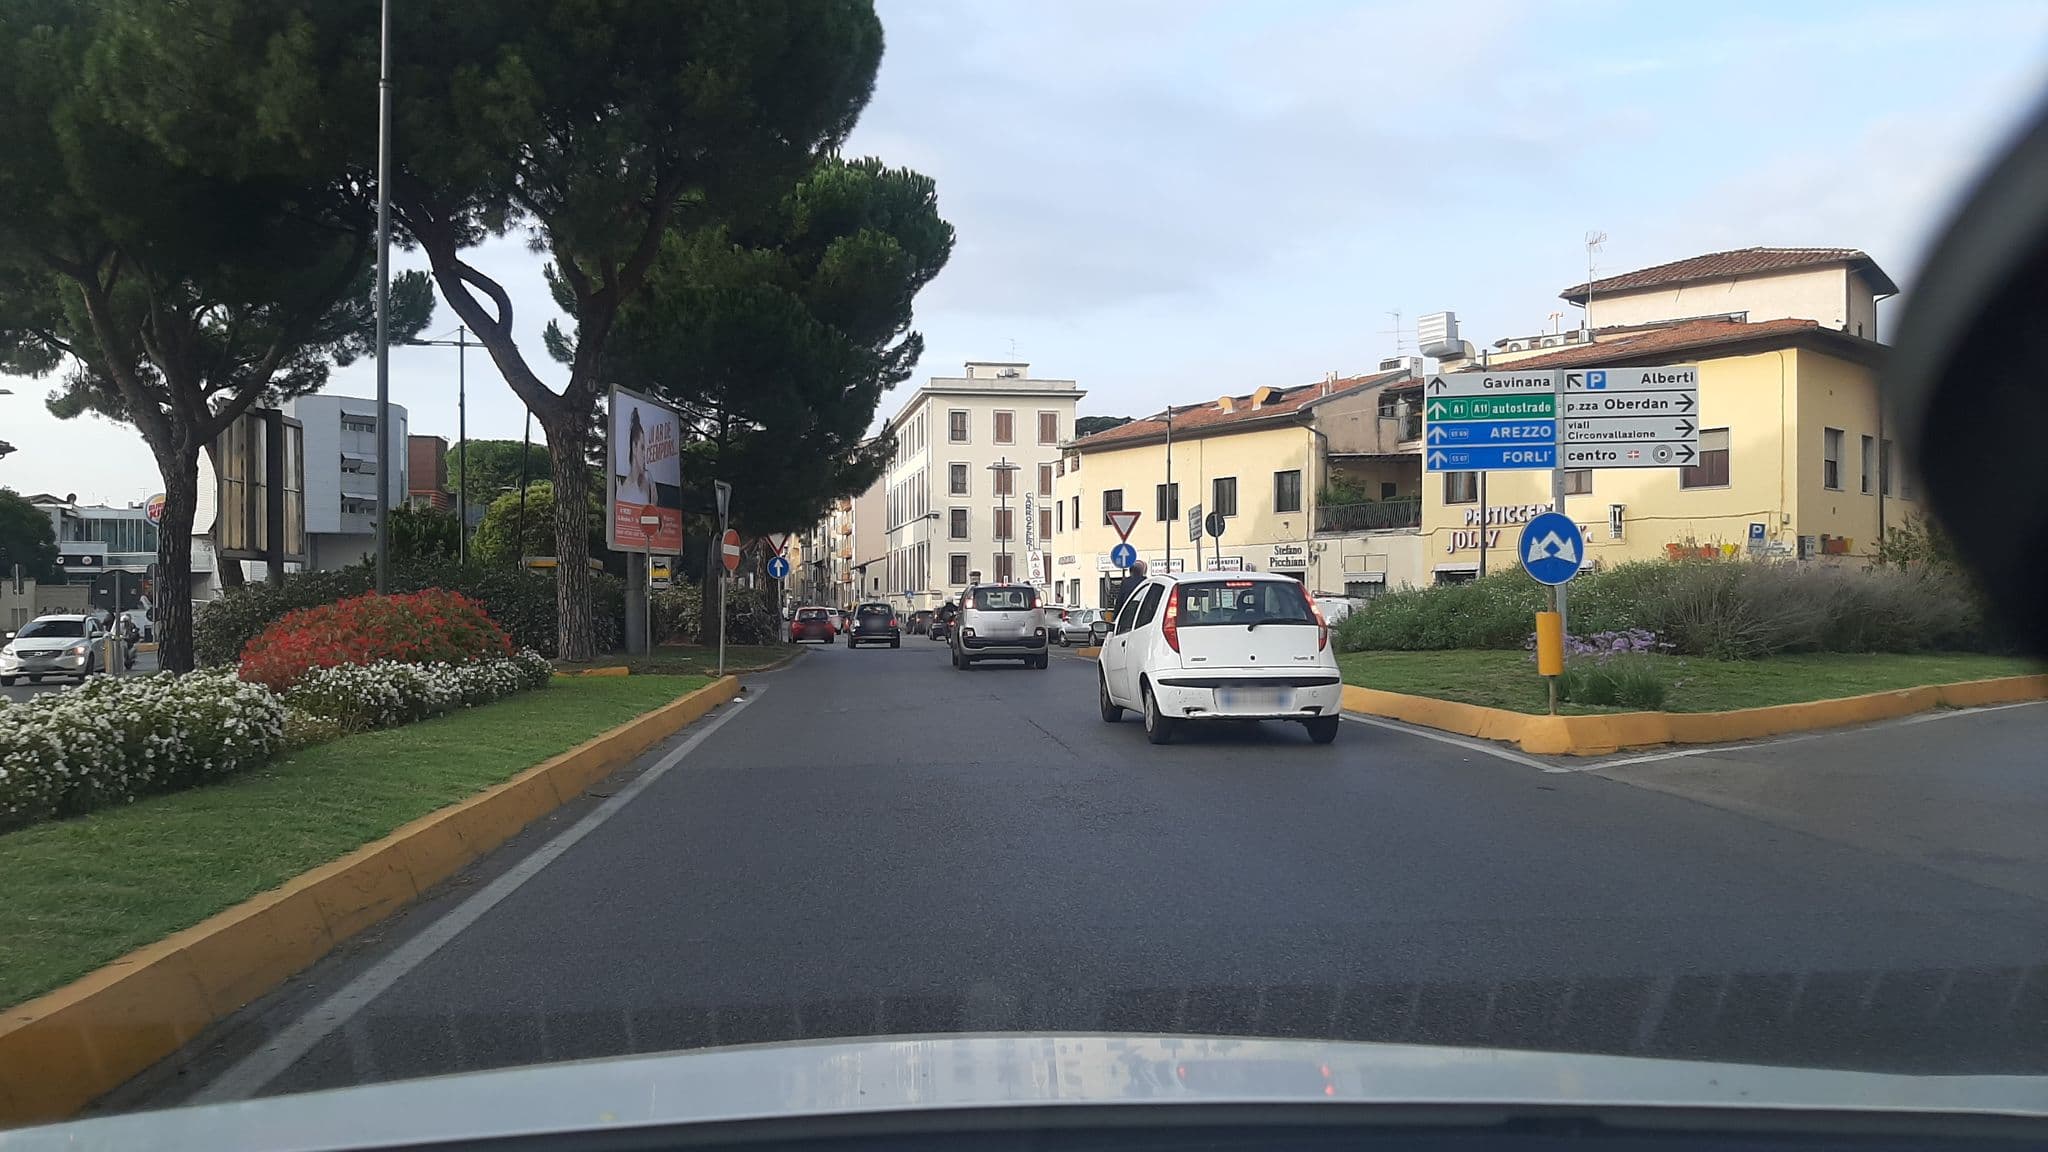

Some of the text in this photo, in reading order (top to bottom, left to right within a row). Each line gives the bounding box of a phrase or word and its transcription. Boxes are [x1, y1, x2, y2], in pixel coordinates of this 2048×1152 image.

[1483, 377, 1551, 388] Gavinana
[1590, 371, 1694, 388] P Alberti
[1453, 402, 1551, 414] A1 A11 autostrade
[1567, 398, 1669, 413] p.zza Oberdan
[1568, 420, 1590, 429] viali
[1490, 426, 1551, 438] AREZZO
[1567, 430, 1656, 440] Circonvallazione
[1502, 450, 1552, 463] FORLI'
[1568, 449, 1617, 461] centro
[1446, 529, 1501, 554] JOLY
[1274, 545, 1303, 555] Stefano
[1270, 556, 1306, 567] Picchiani
